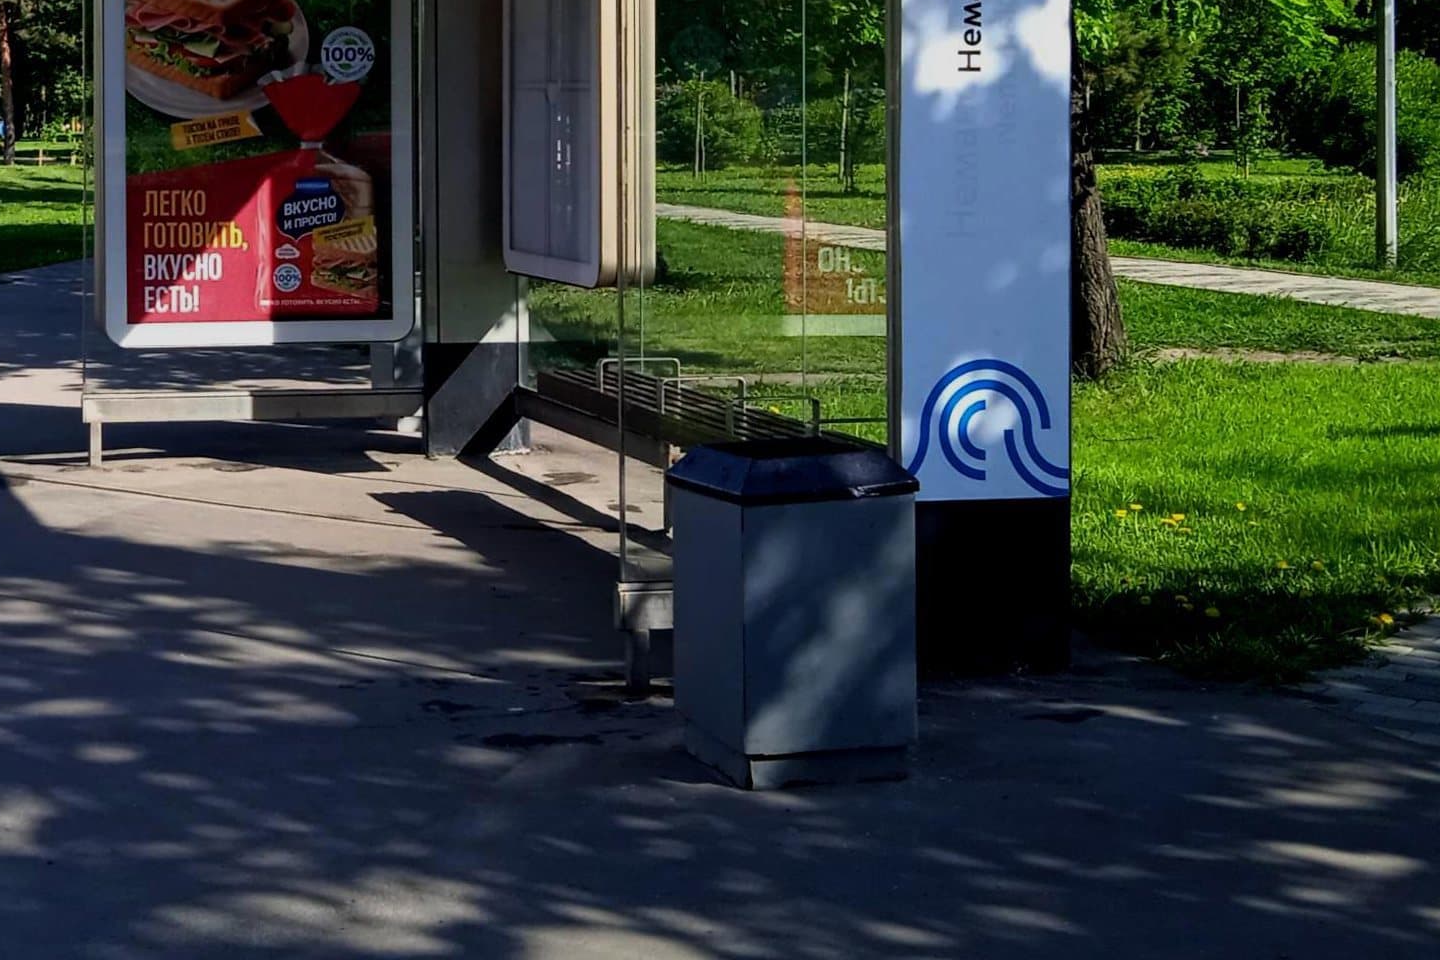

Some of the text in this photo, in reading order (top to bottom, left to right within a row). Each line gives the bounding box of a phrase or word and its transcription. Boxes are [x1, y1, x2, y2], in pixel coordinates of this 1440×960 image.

[323, 46, 375, 62] 100%
[143, 189, 207, 216] ЛЕГКО
[283, 195, 337, 216] ВКУСНО
[283, 212, 337, 231] И ПРОСТО!
[144, 220, 249, 251] ГОТОВИТЬ,
[144, 252, 223, 281] ВКУСНО
[144, 285, 200, 313] ЕСТЬ!
